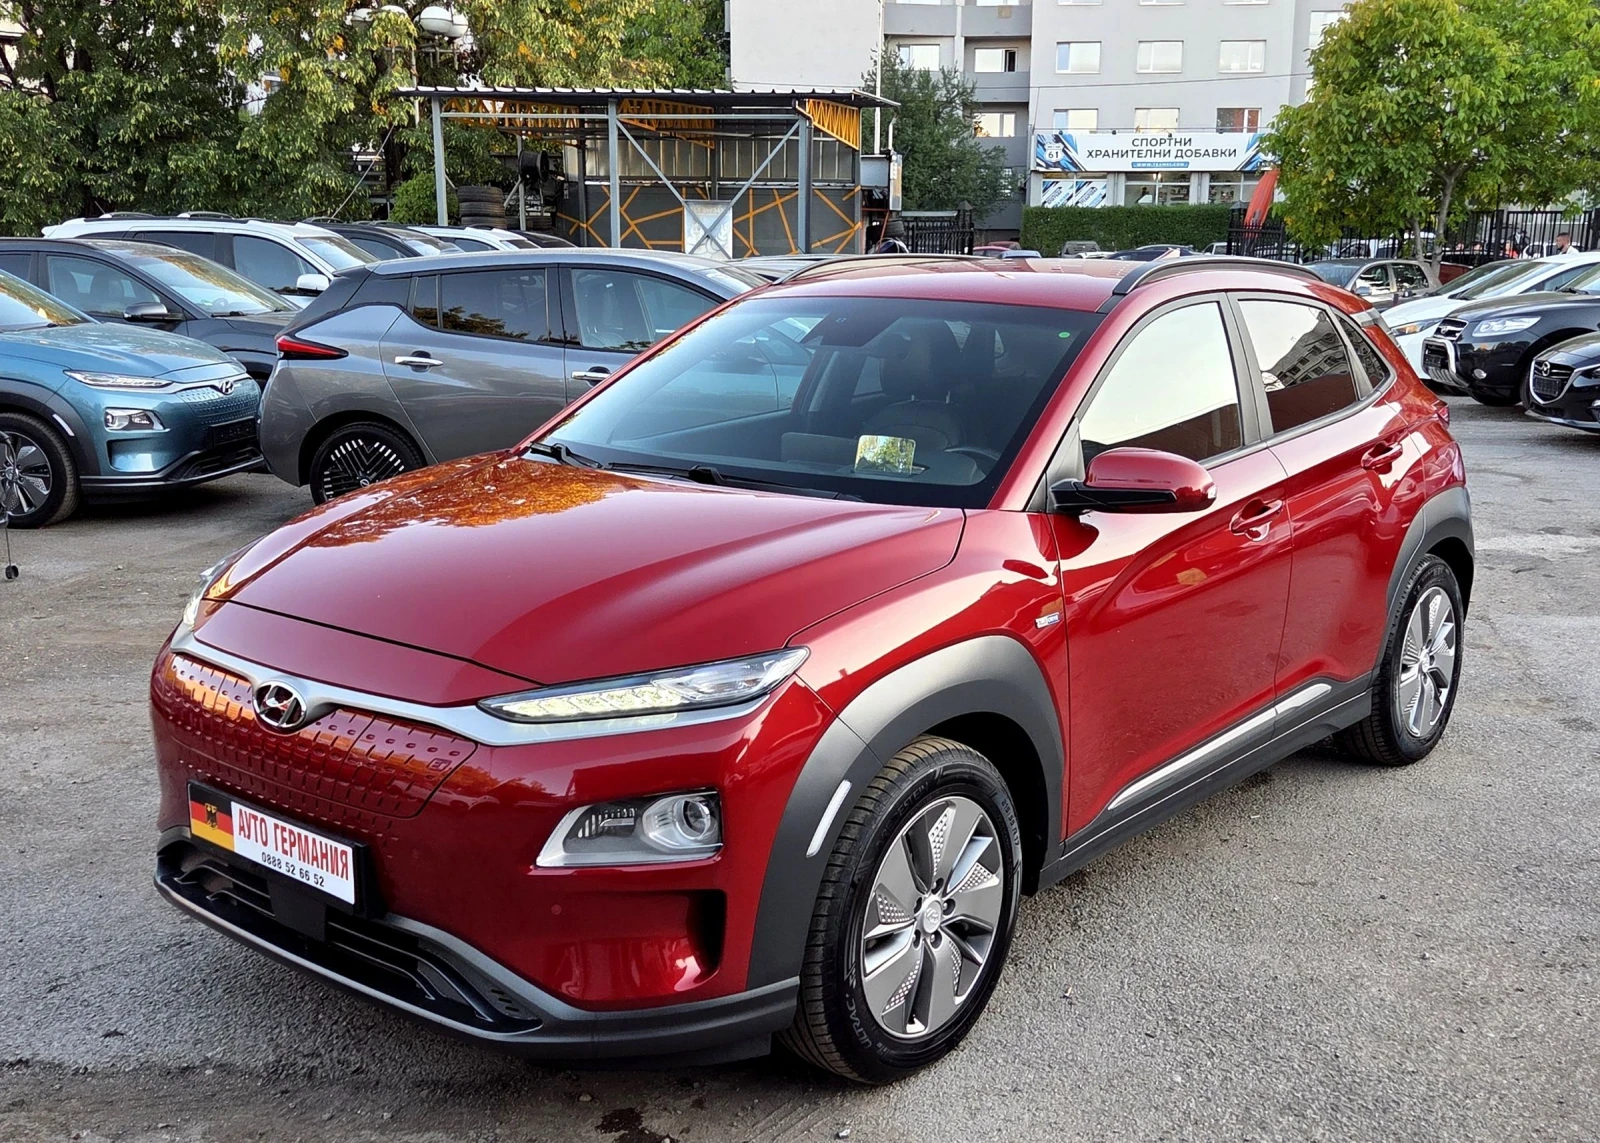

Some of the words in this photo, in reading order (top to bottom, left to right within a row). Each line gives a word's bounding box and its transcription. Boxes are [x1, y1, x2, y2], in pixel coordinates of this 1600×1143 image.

[1131, 137, 1192, 147] СПОРТНИ
[1048, 151, 1059, 159] 61
[1086, 149, 1171, 159] ХРАНИТЕЛНИ
[1174, 148, 1237, 160] ДОБАВКИ
[238, 808, 268, 847] АУТО
[273, 822, 349, 881] ГЕРМАНИЯ
[261, 851, 282, 869] 0888
[285, 861, 296, 875] 52
[299, 867, 310, 881] 66
[313, 873, 325, 887] 52
